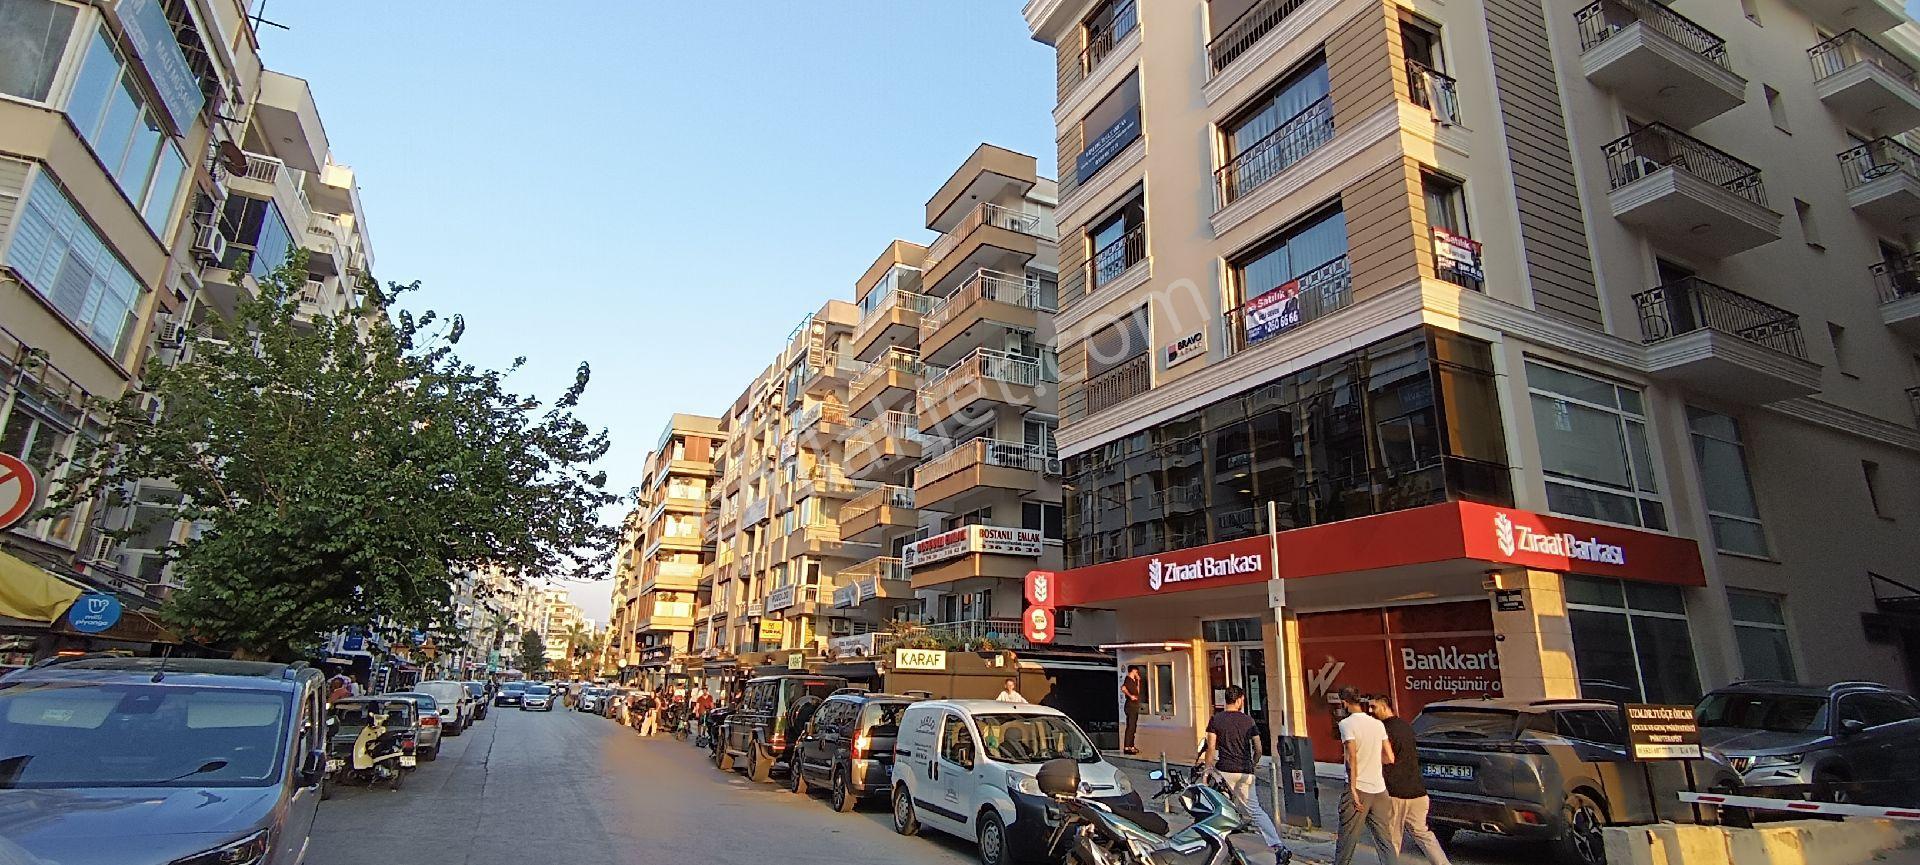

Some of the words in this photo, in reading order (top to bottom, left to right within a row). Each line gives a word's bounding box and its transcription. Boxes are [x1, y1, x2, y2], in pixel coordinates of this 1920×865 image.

[1257, 290, 1285, 308] Satılık
[1178, 332, 1202, 350] BRAVO
[979, 528, 1012, 540] BOSTANLI
[1018, 532, 1040, 543] EMLAK
[1514, 524, 1566, 557] Ziraat
[1562, 534, 1624, 564] Bankası
[1164, 560, 1204, 582] Ziraat
[1204, 554, 1262, 577] Bankası
[902, 652, 940, 666] KARAF
[1400, 646, 1498, 670] Bankkart
[1405, 676, 1432, 690] Seni
[1434, 676, 1490, 695] düşünür
